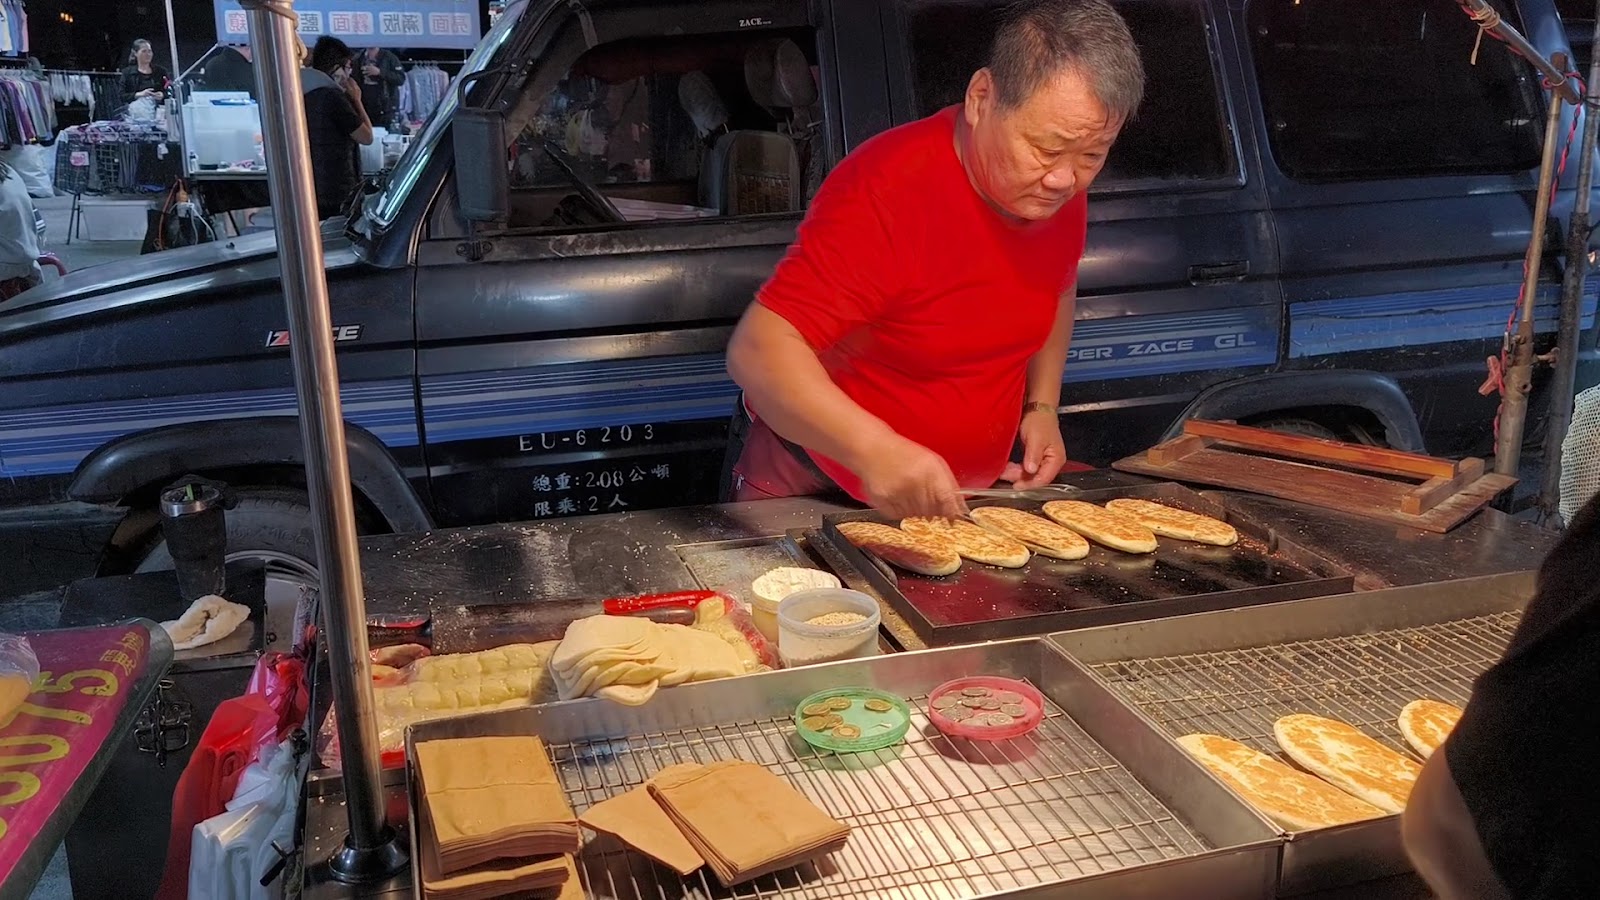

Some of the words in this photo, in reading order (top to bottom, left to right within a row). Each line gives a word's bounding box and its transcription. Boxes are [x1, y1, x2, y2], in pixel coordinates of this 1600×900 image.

[739, 18, 762, 27] ZACE
[267, 325, 360, 347] ZE
[1066, 347, 1113, 360] PER
[1127, 339, 1194, 356] ZACE
[1214, 333, 1257, 349] GL
